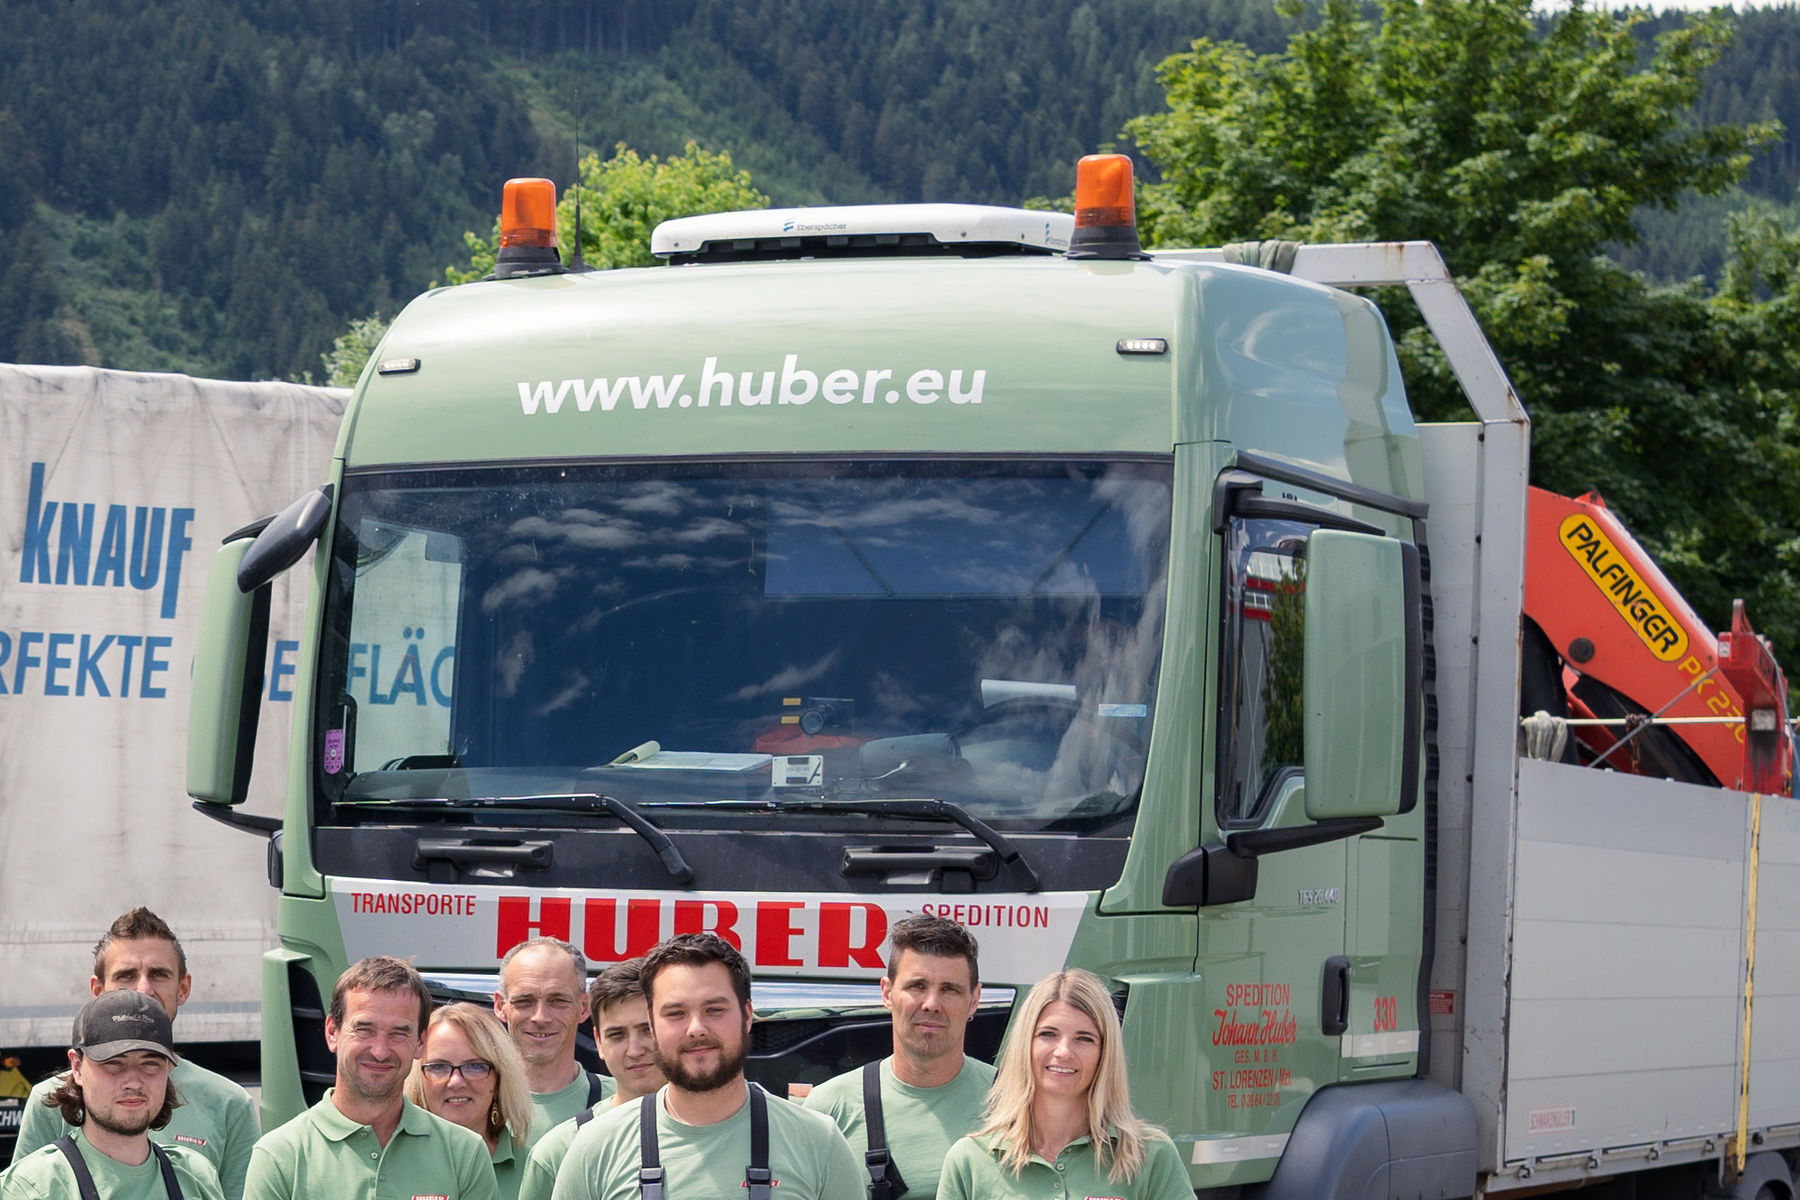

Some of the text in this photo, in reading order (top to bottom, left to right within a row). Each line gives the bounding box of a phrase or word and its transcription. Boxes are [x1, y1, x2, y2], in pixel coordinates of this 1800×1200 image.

[517, 354, 987, 415] www.huber.eu
[1567, 522, 1679, 654] PALFINGER
[1677, 655, 1715, 695] PK
[351, 892, 477, 916] TRANSPORTE
[1226, 984, 1291, 1007] SPEDITION
[1212, 1009, 1298, 1047] Johann Huber
[1373, 996, 1398, 1033] 330
[1212, 1070, 1227, 1091] ST.
[1230, 1068, 1274, 1089] LORENZEN
